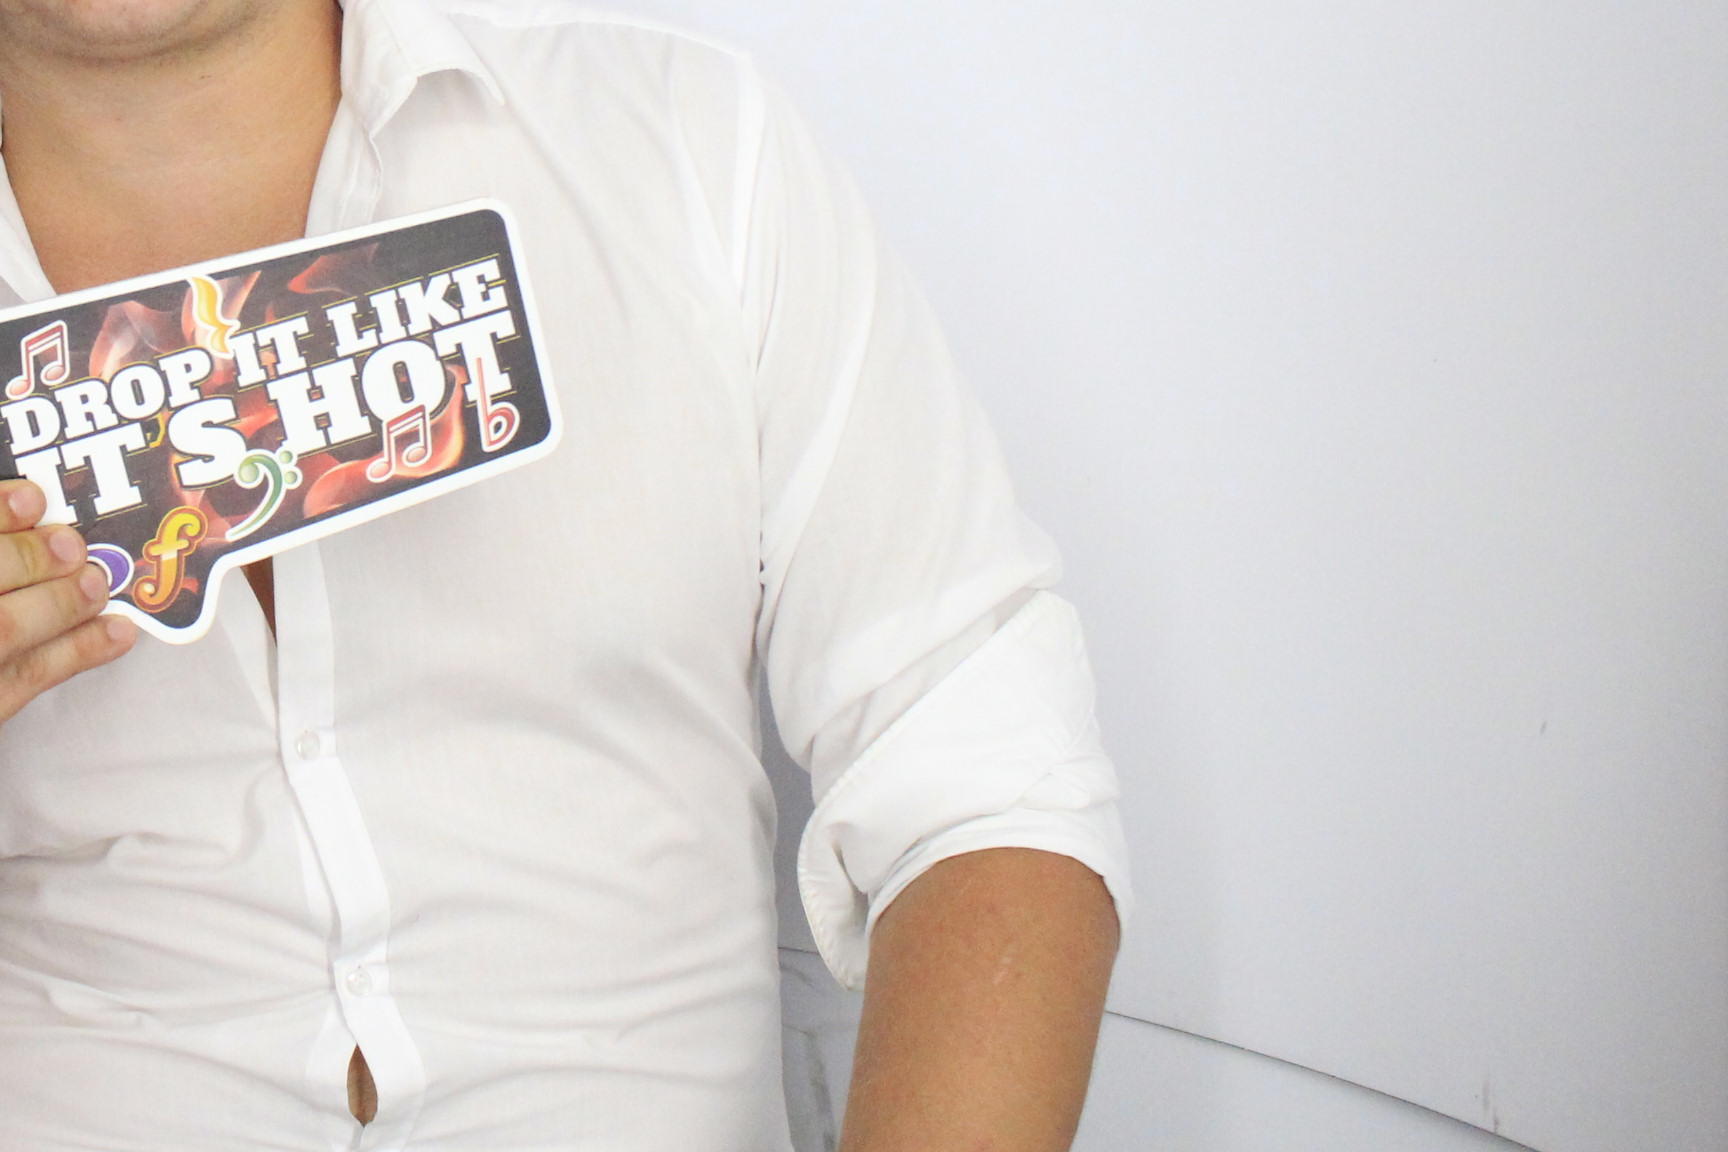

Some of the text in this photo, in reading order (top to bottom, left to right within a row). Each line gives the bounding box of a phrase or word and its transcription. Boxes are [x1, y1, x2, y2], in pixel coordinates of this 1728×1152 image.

[0, 260, 507, 456] DROP IT LIKE
[268, 311, 516, 454] HOT
